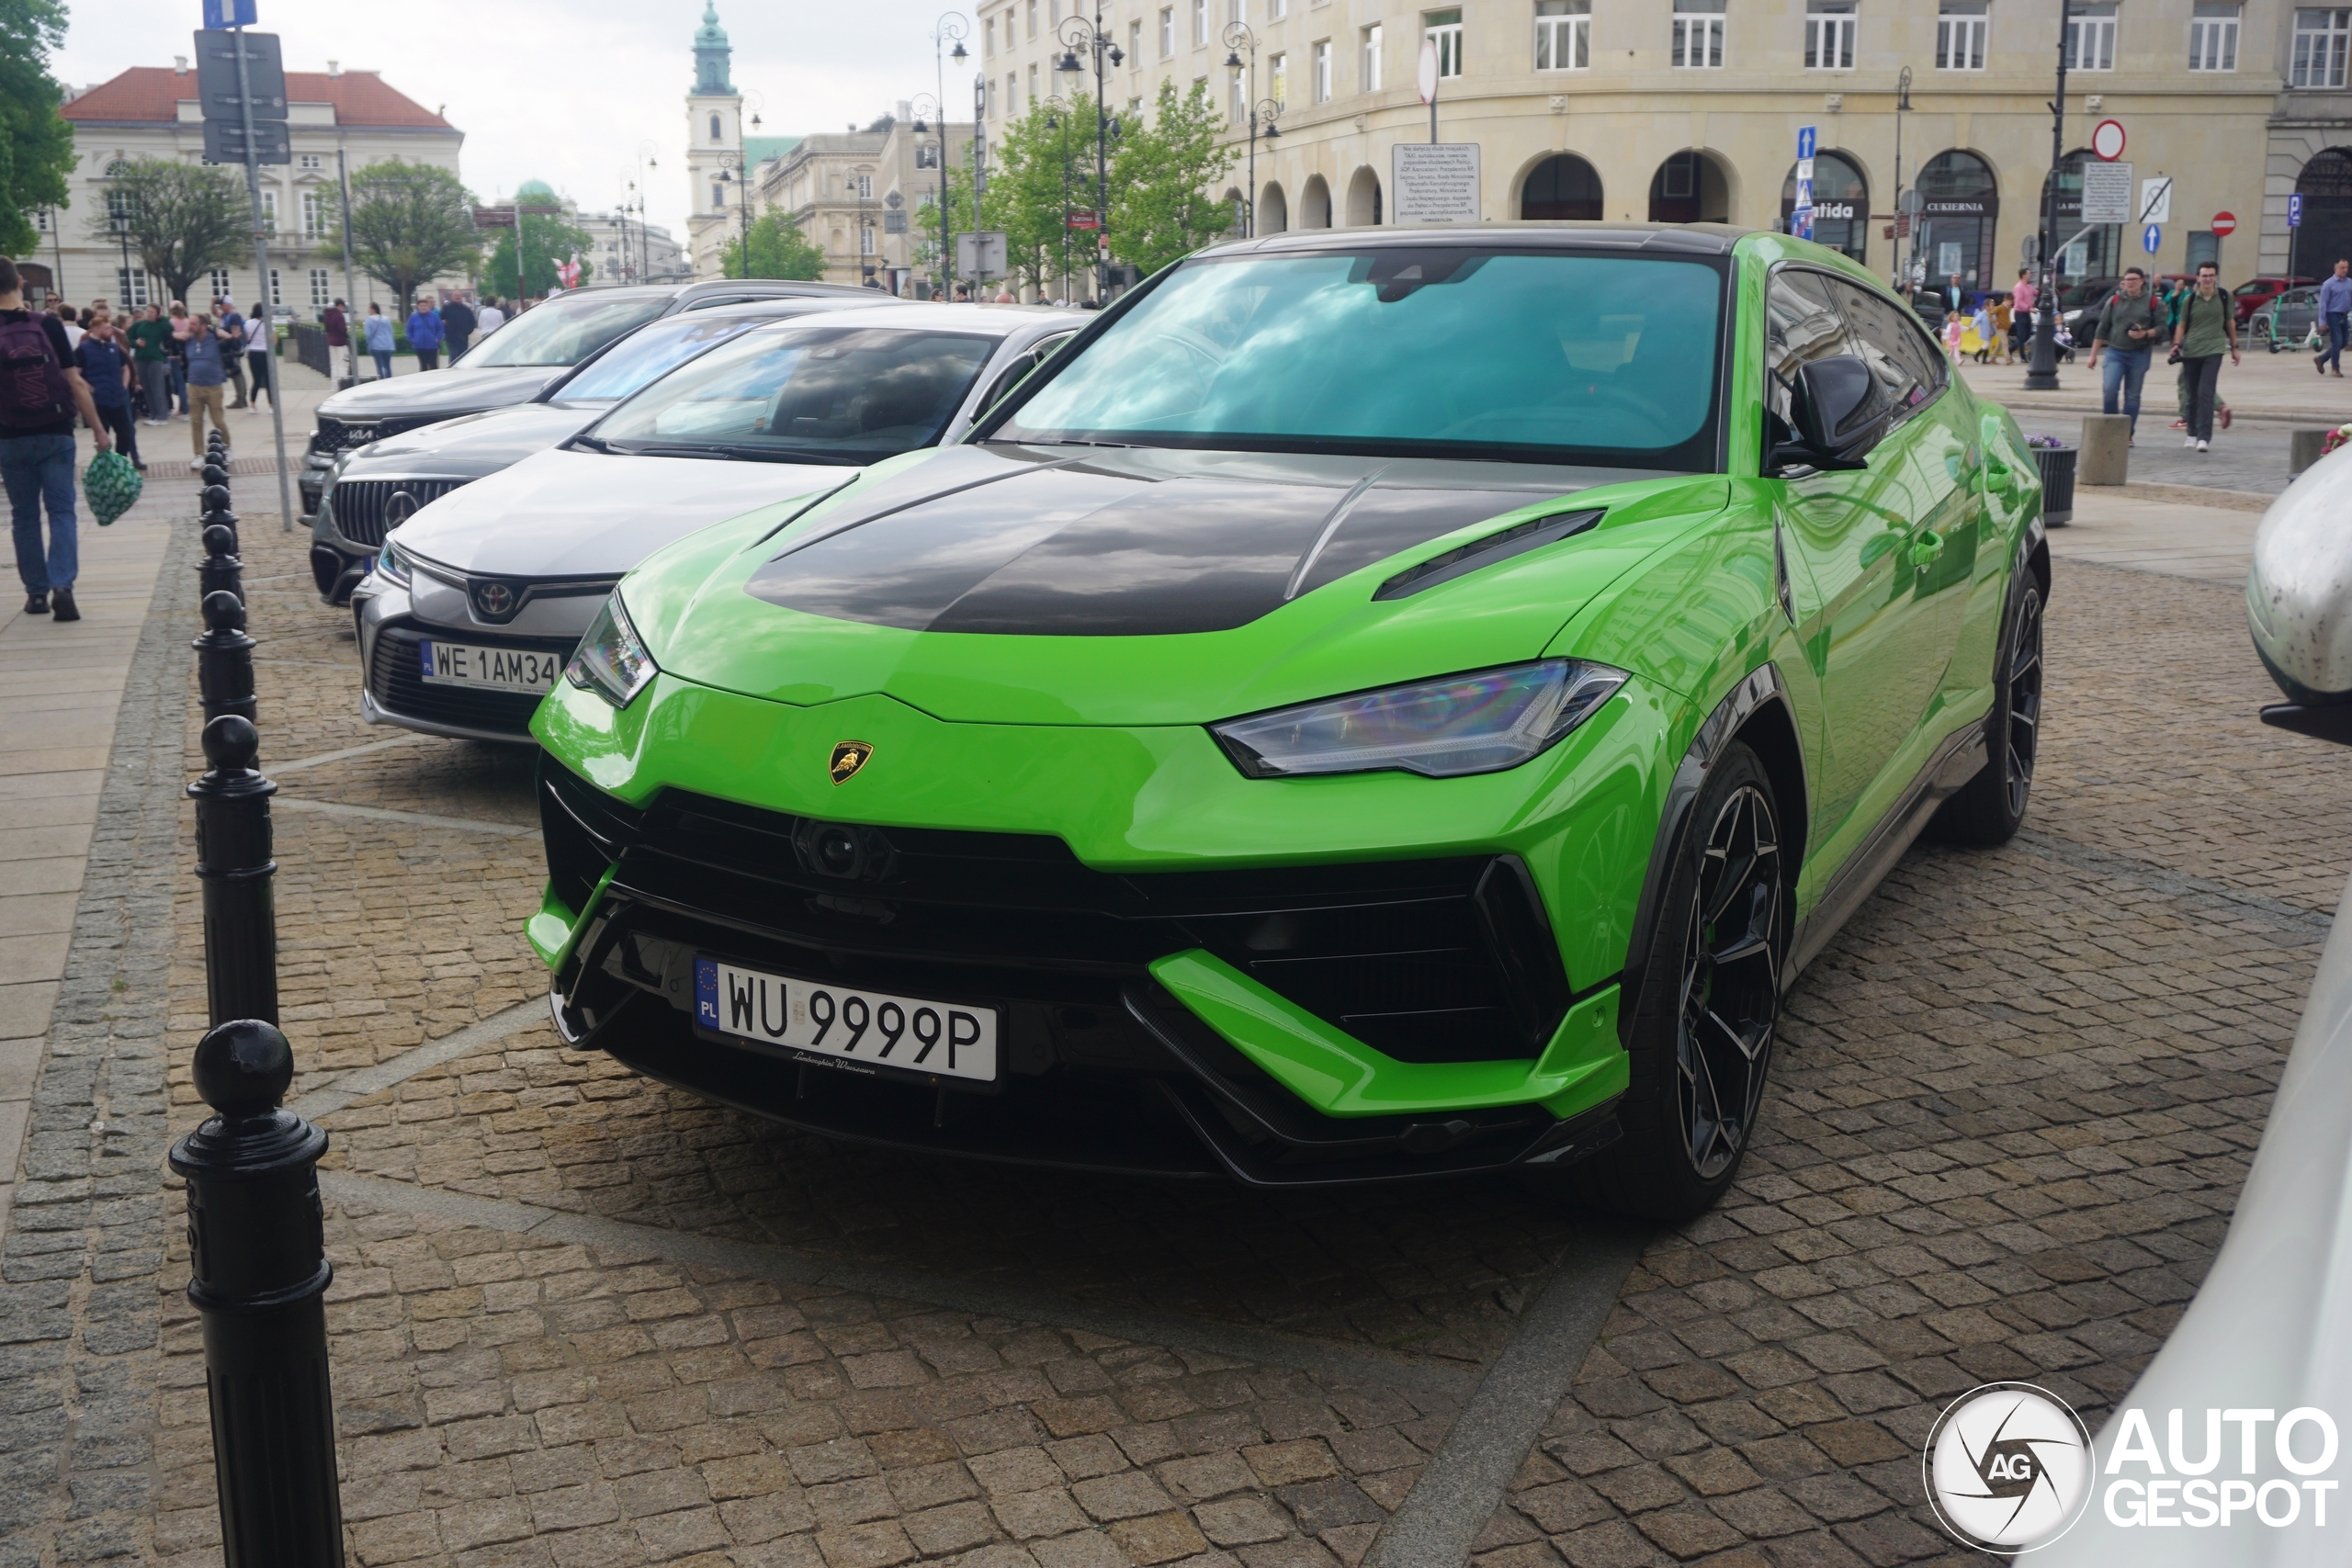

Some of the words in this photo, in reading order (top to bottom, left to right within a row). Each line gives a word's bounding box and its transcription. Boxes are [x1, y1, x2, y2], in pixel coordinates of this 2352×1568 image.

[1812, 202, 1853, 218] atida
[1927, 202, 1984, 211] CUKIERNIA
[2290, 196, 2300, 217] P
[348, 429, 373, 439] KIA
[424, 662, 432, 671] PL
[436, 646, 468, 677] WE
[478, 649, 555, 686] 1AM34
[837, 742, 871, 752] LAMBORGHINI
[701, 1000, 717, 1019] PL
[727, 972, 788, 1038] WU
[808, 990, 981, 1069] 9999P
[792, 1051, 834, 1067] Lamborghini
[835, 1058, 876, 1075] Warszawa
